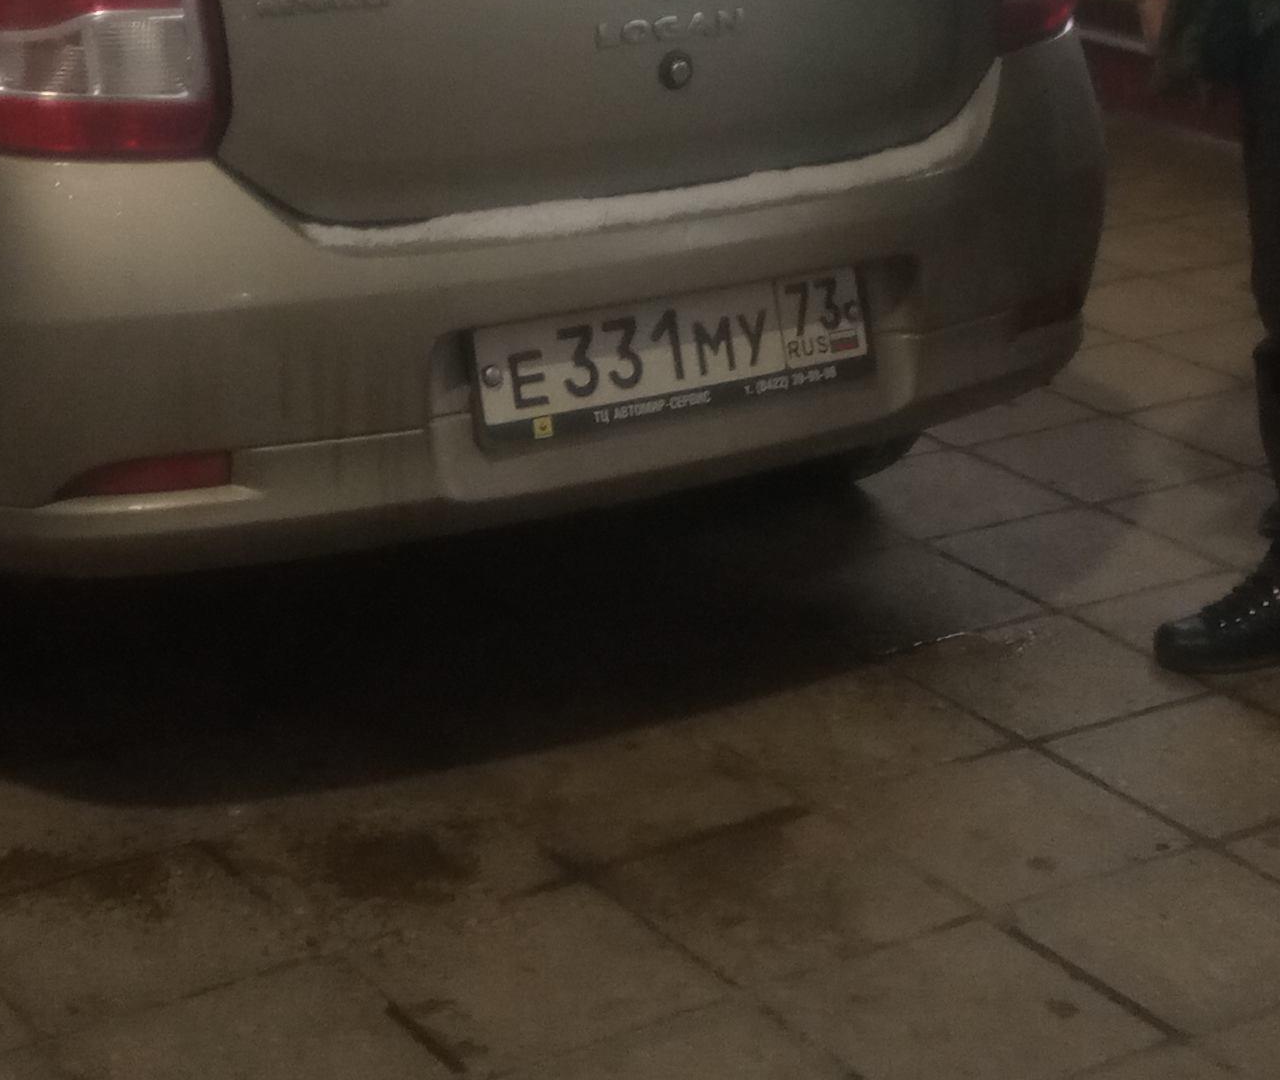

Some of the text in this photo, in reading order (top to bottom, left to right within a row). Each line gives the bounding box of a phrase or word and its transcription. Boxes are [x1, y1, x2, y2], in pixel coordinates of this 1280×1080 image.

[594, 7, 744, 49] LOGAN
[784, 277, 843, 337] 73
[788, 335, 829, 359] RUS
[593, 409, 610, 424] ТЦ
